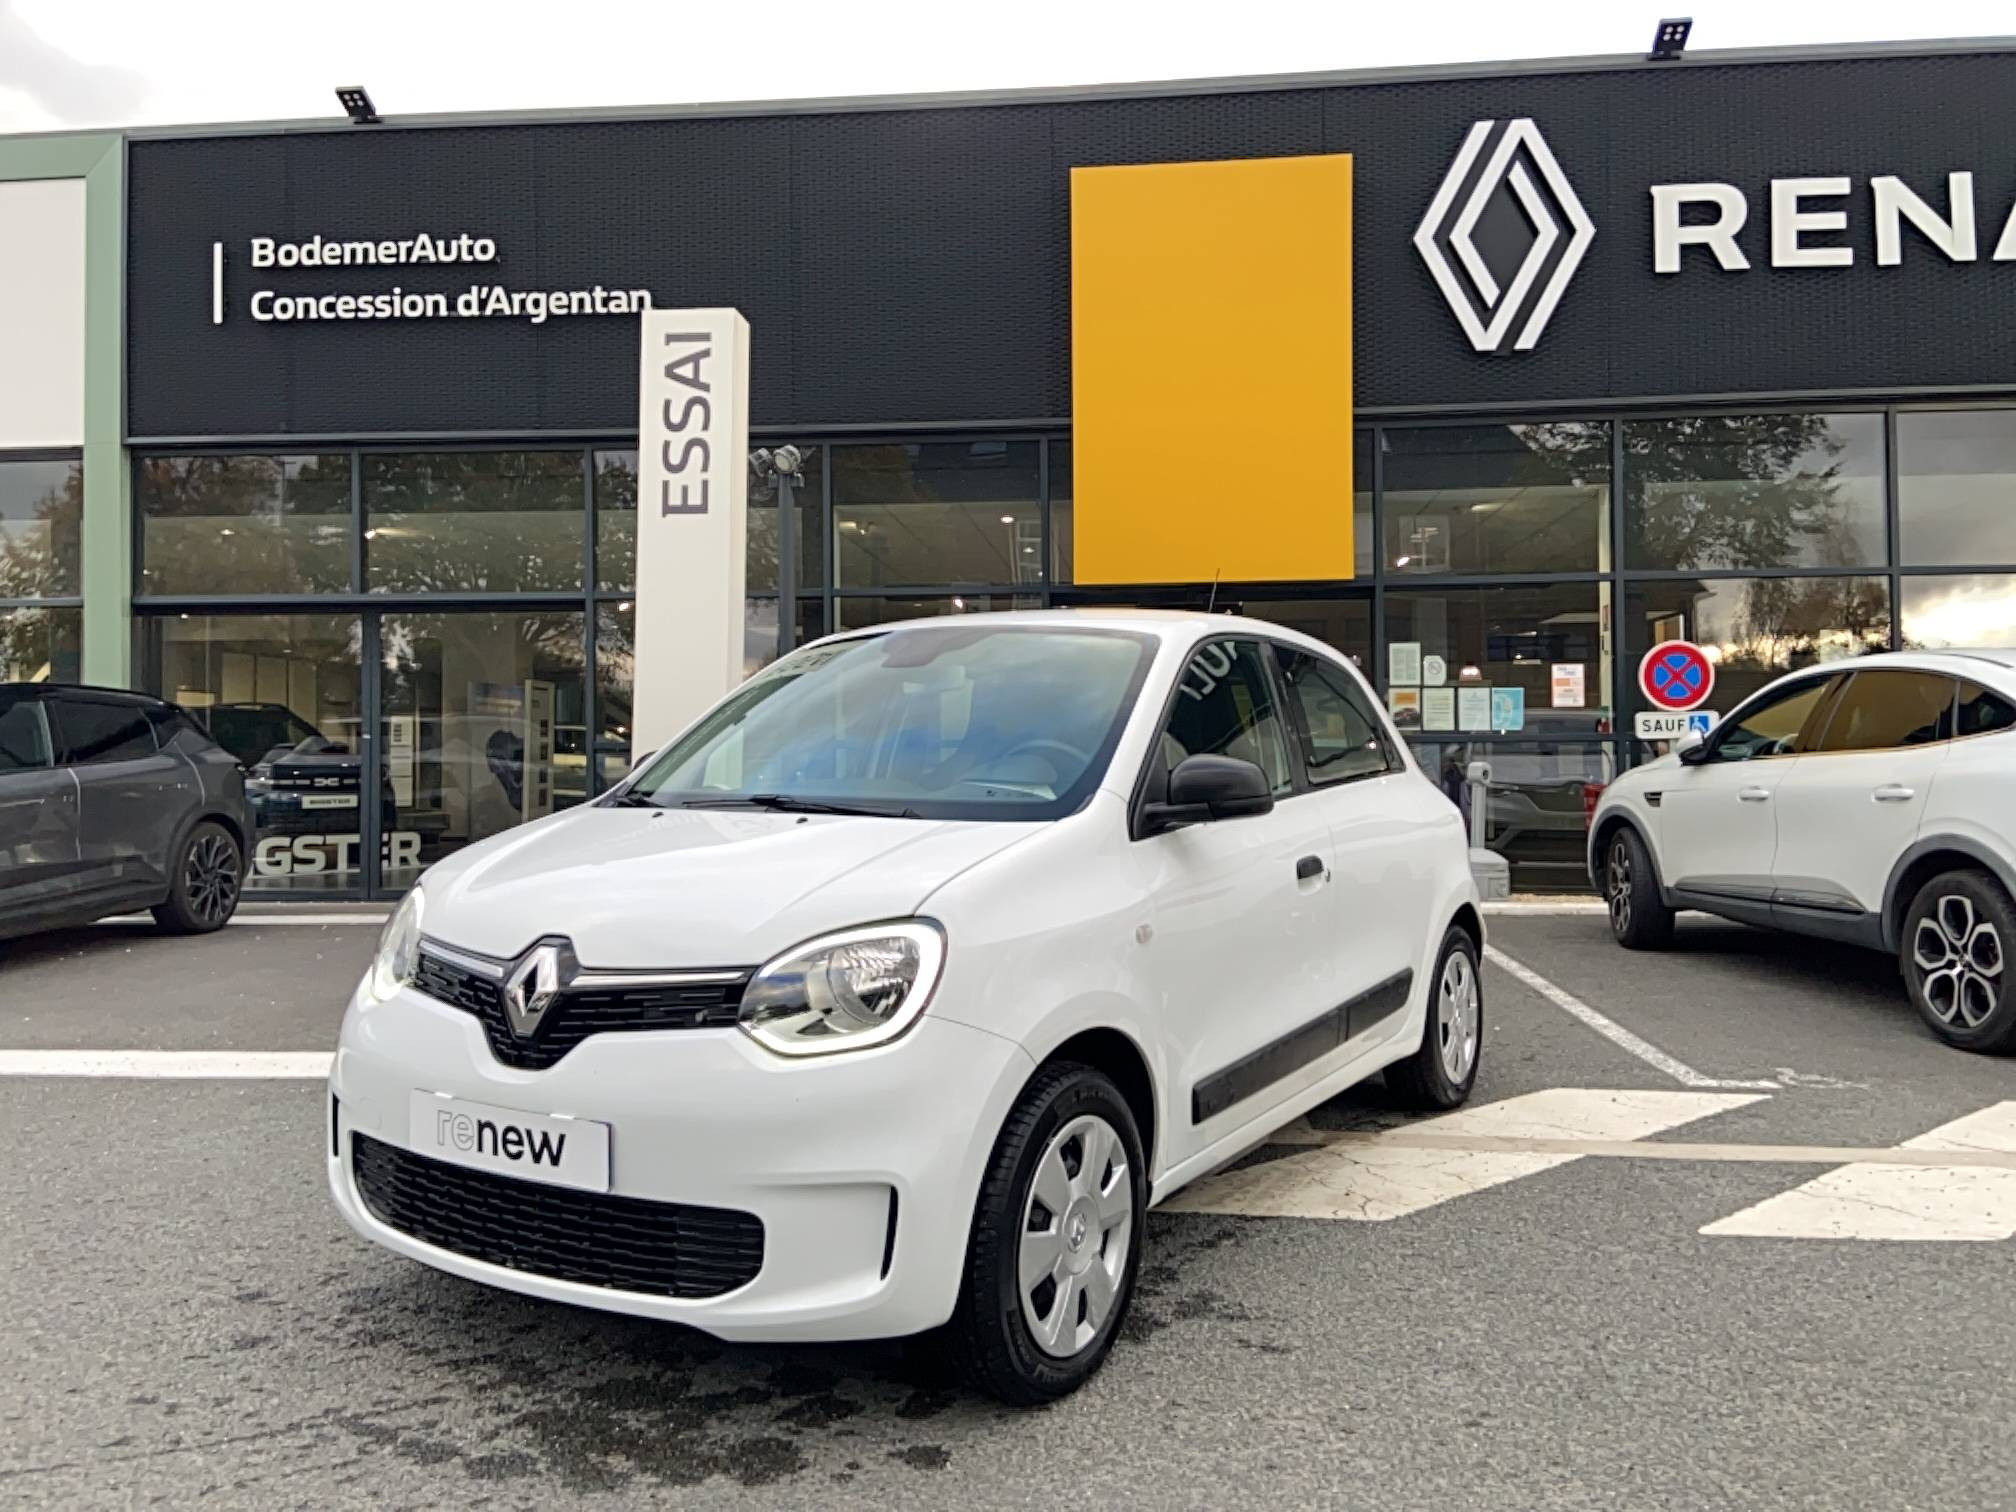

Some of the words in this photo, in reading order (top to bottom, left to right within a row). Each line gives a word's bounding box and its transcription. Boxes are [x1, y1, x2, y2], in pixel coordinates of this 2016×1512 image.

[1650, 171, 2016, 274] REN
[251, 233, 496, 268] BodemerAuto
[251, 287, 448, 321] Concession
[662, 332, 712, 518] ESSAI
[1642, 718, 1686, 732] SAUF
[437, 1110, 566, 1167] renew
